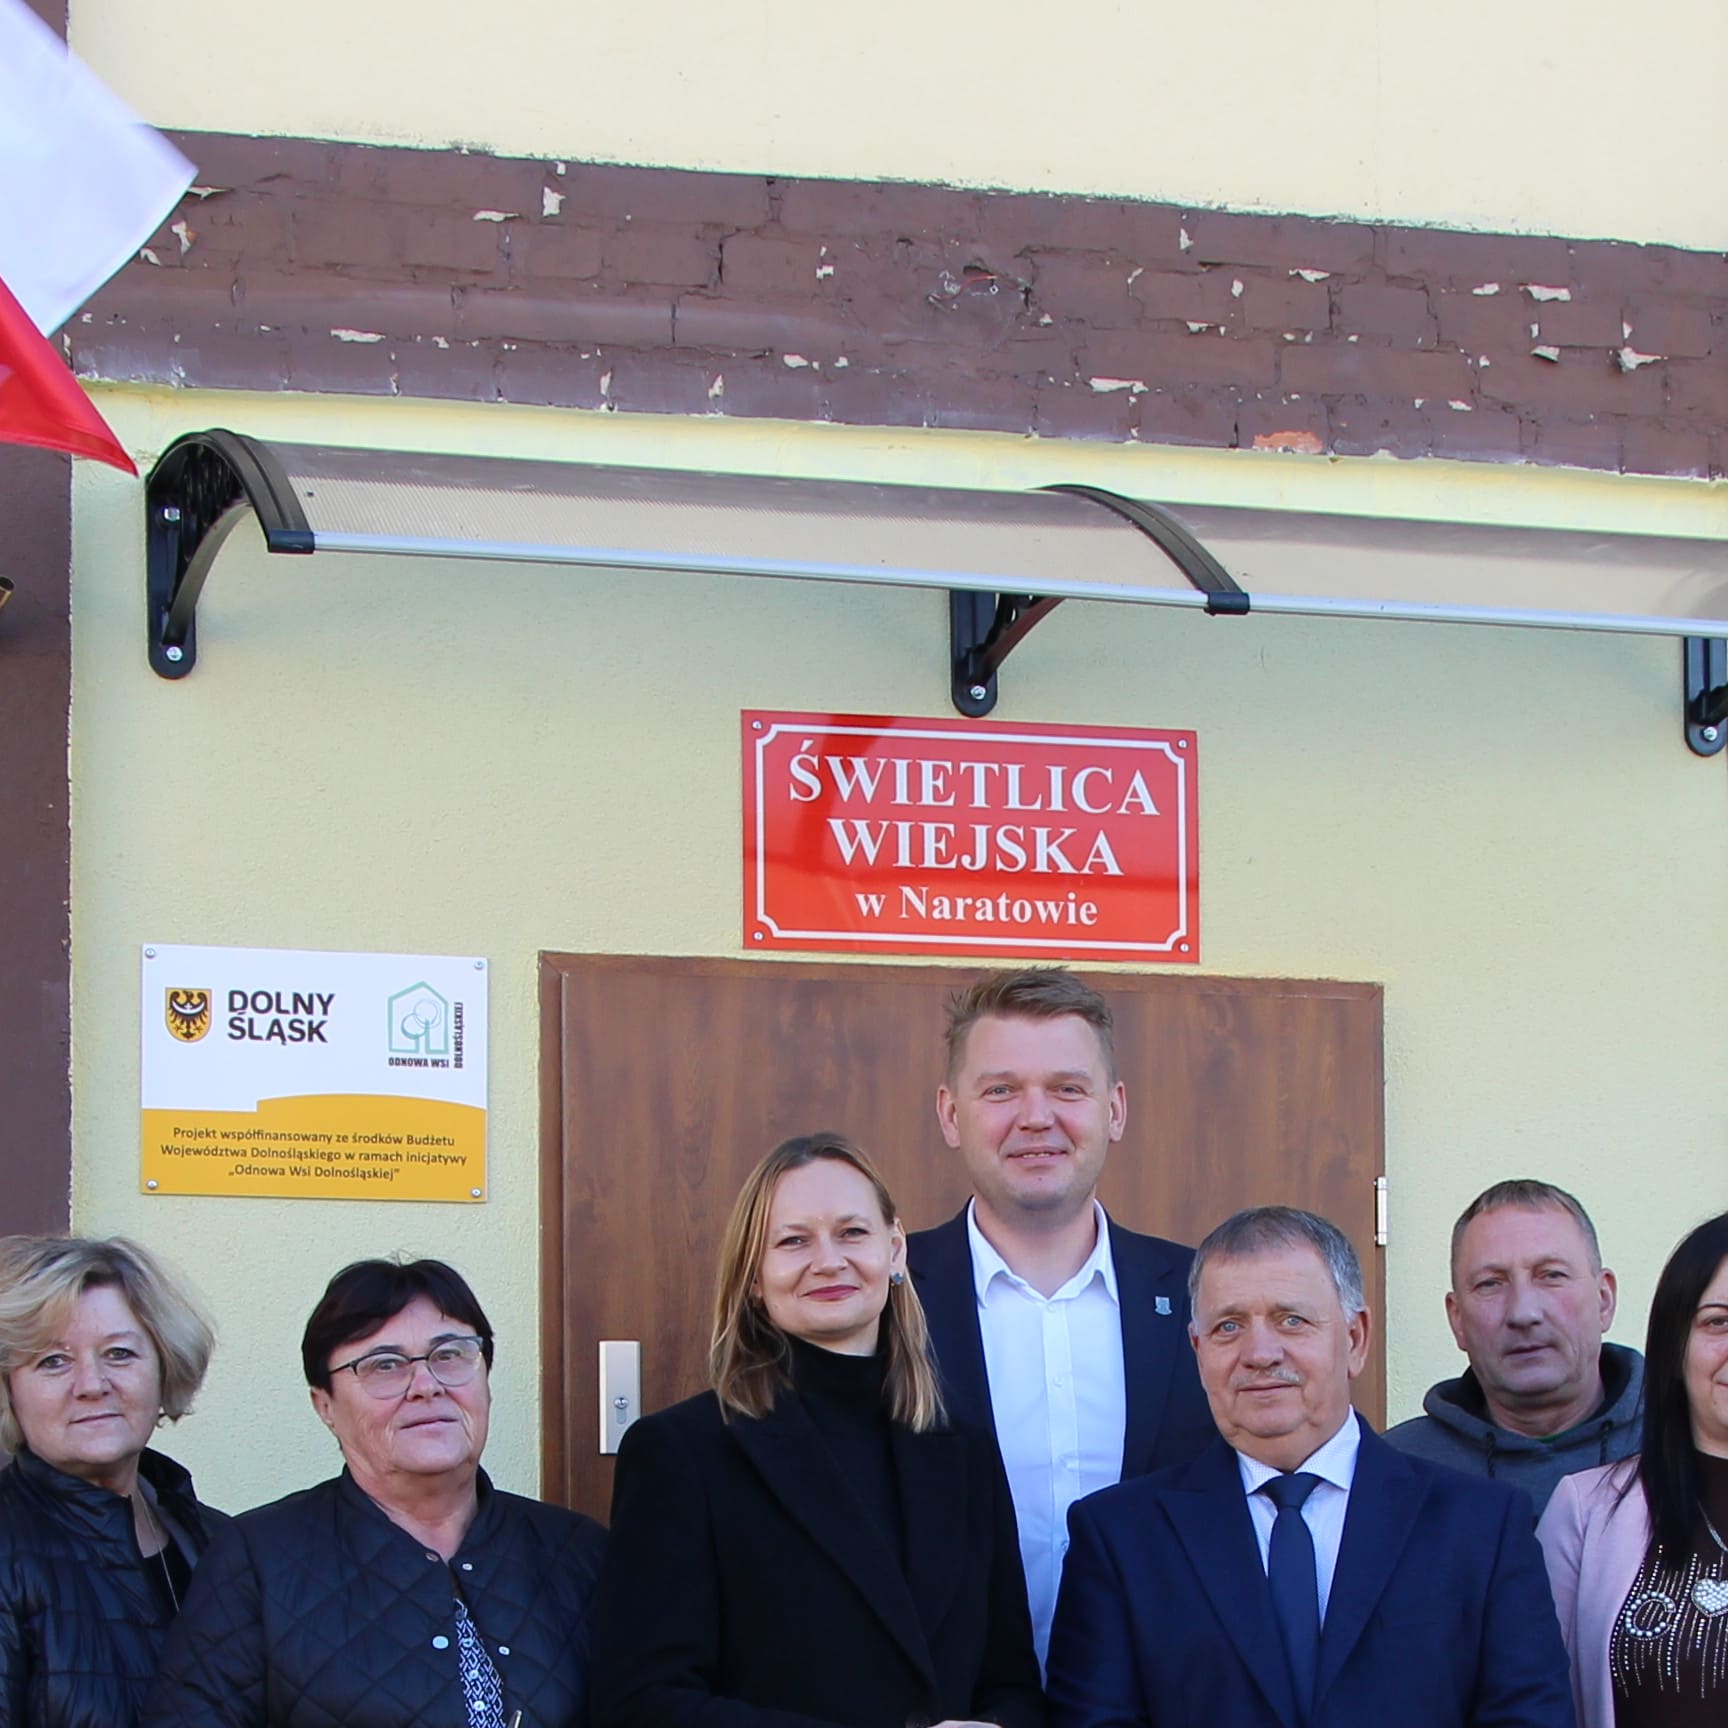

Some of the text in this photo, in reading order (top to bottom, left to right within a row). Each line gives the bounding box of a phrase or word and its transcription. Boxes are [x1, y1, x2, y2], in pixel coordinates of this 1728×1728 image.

[788, 739, 1161, 816] ŚWIETLICA
[827, 818, 1124, 876] WIEJSKA
[855, 886, 1098, 926] w Naratowie
[227, 989, 336, 1017] DOLNY
[227, 1009, 328, 1046] ŚLĄSK
[388, 1056, 450, 1068] ODNOWA WSI
[173, 1127, 455, 1147] Projekt współfinansowany ze środków Budżetu
[160, 1144, 467, 1167] Województwa Dolnośląskiego w ramach inicjatywy
[289, 1165, 311, 1177] Wsi
